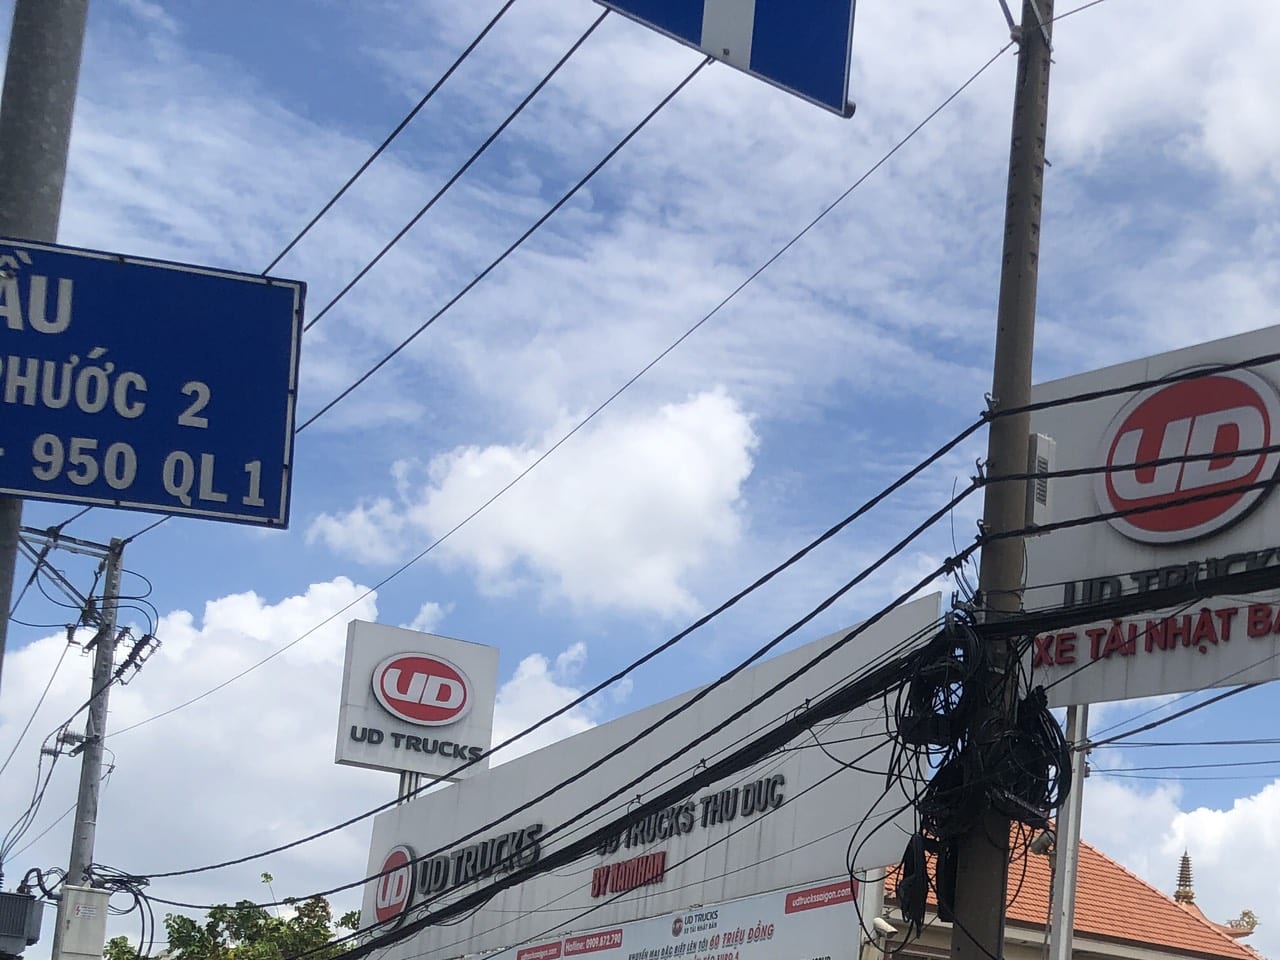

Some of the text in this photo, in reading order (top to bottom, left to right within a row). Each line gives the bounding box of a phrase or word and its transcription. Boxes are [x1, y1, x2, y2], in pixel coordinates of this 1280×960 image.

[0, 346, 211, 429] HƯỚC 2
[32, 433, 138, 490] 950
[1110, 405, 1266, 502] UD
[1033, 631, 1077, 668] XE
[1085, 617, 1138, 661] TẢI
[1144, 606, 1239, 655] NHẬT
[382, 667, 465, 710] UD
[350, 725, 484, 761] UD TRUCKS
[624, 801, 696, 849] TRUCKS
[377, 865, 409, 910] UD
[415, 823, 543, 895] UD TRUCKS
